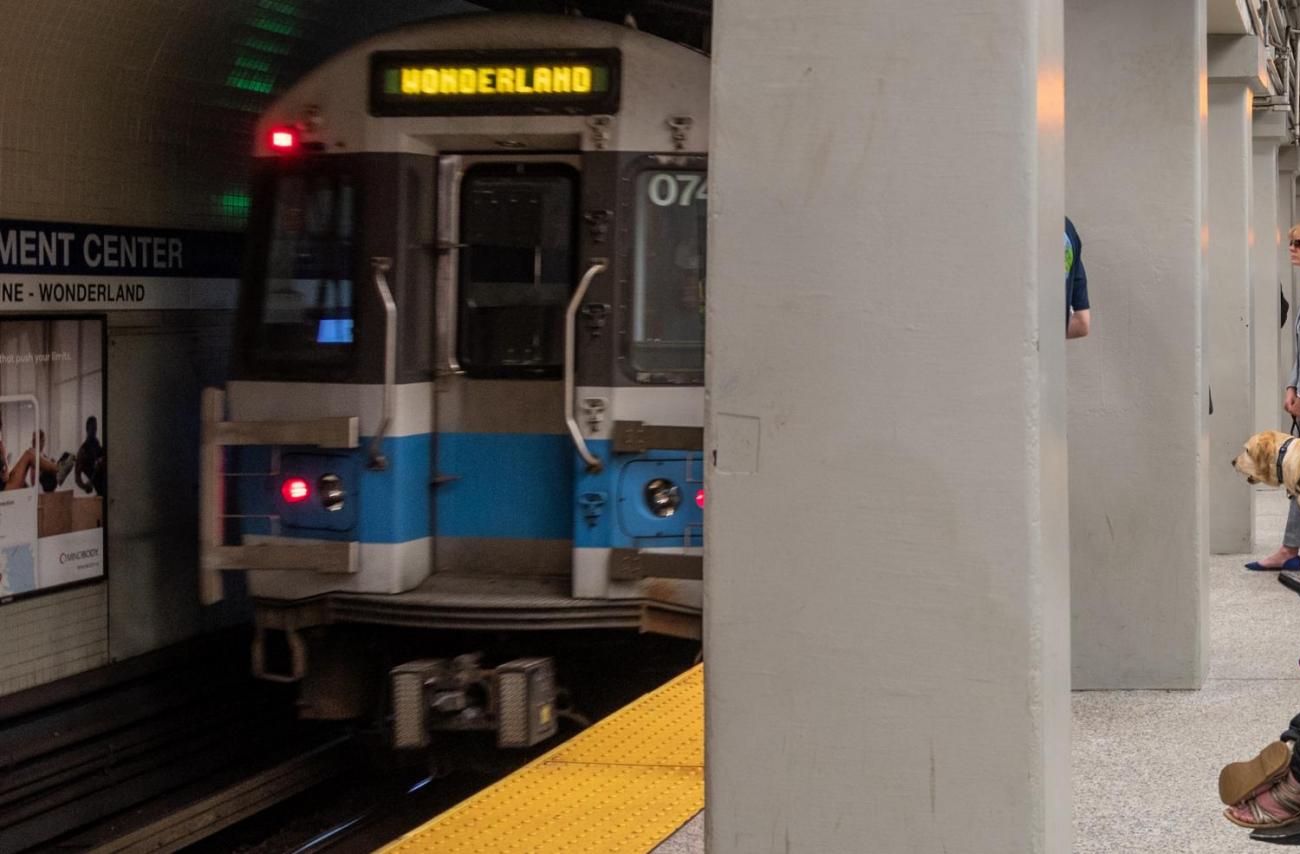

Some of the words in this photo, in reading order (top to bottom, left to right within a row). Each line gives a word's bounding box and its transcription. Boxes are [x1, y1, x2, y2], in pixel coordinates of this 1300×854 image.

[401, 67, 592, 94] WONDERLAND
[0, 229, 75, 267] MENT
[83, 233, 183, 269] CENTER
[2, 283, 24, 302] NE
[39, 283, 145, 302] WONDERLAND
[16, 353, 33, 365] push
[34, 355, 50, 364] your
